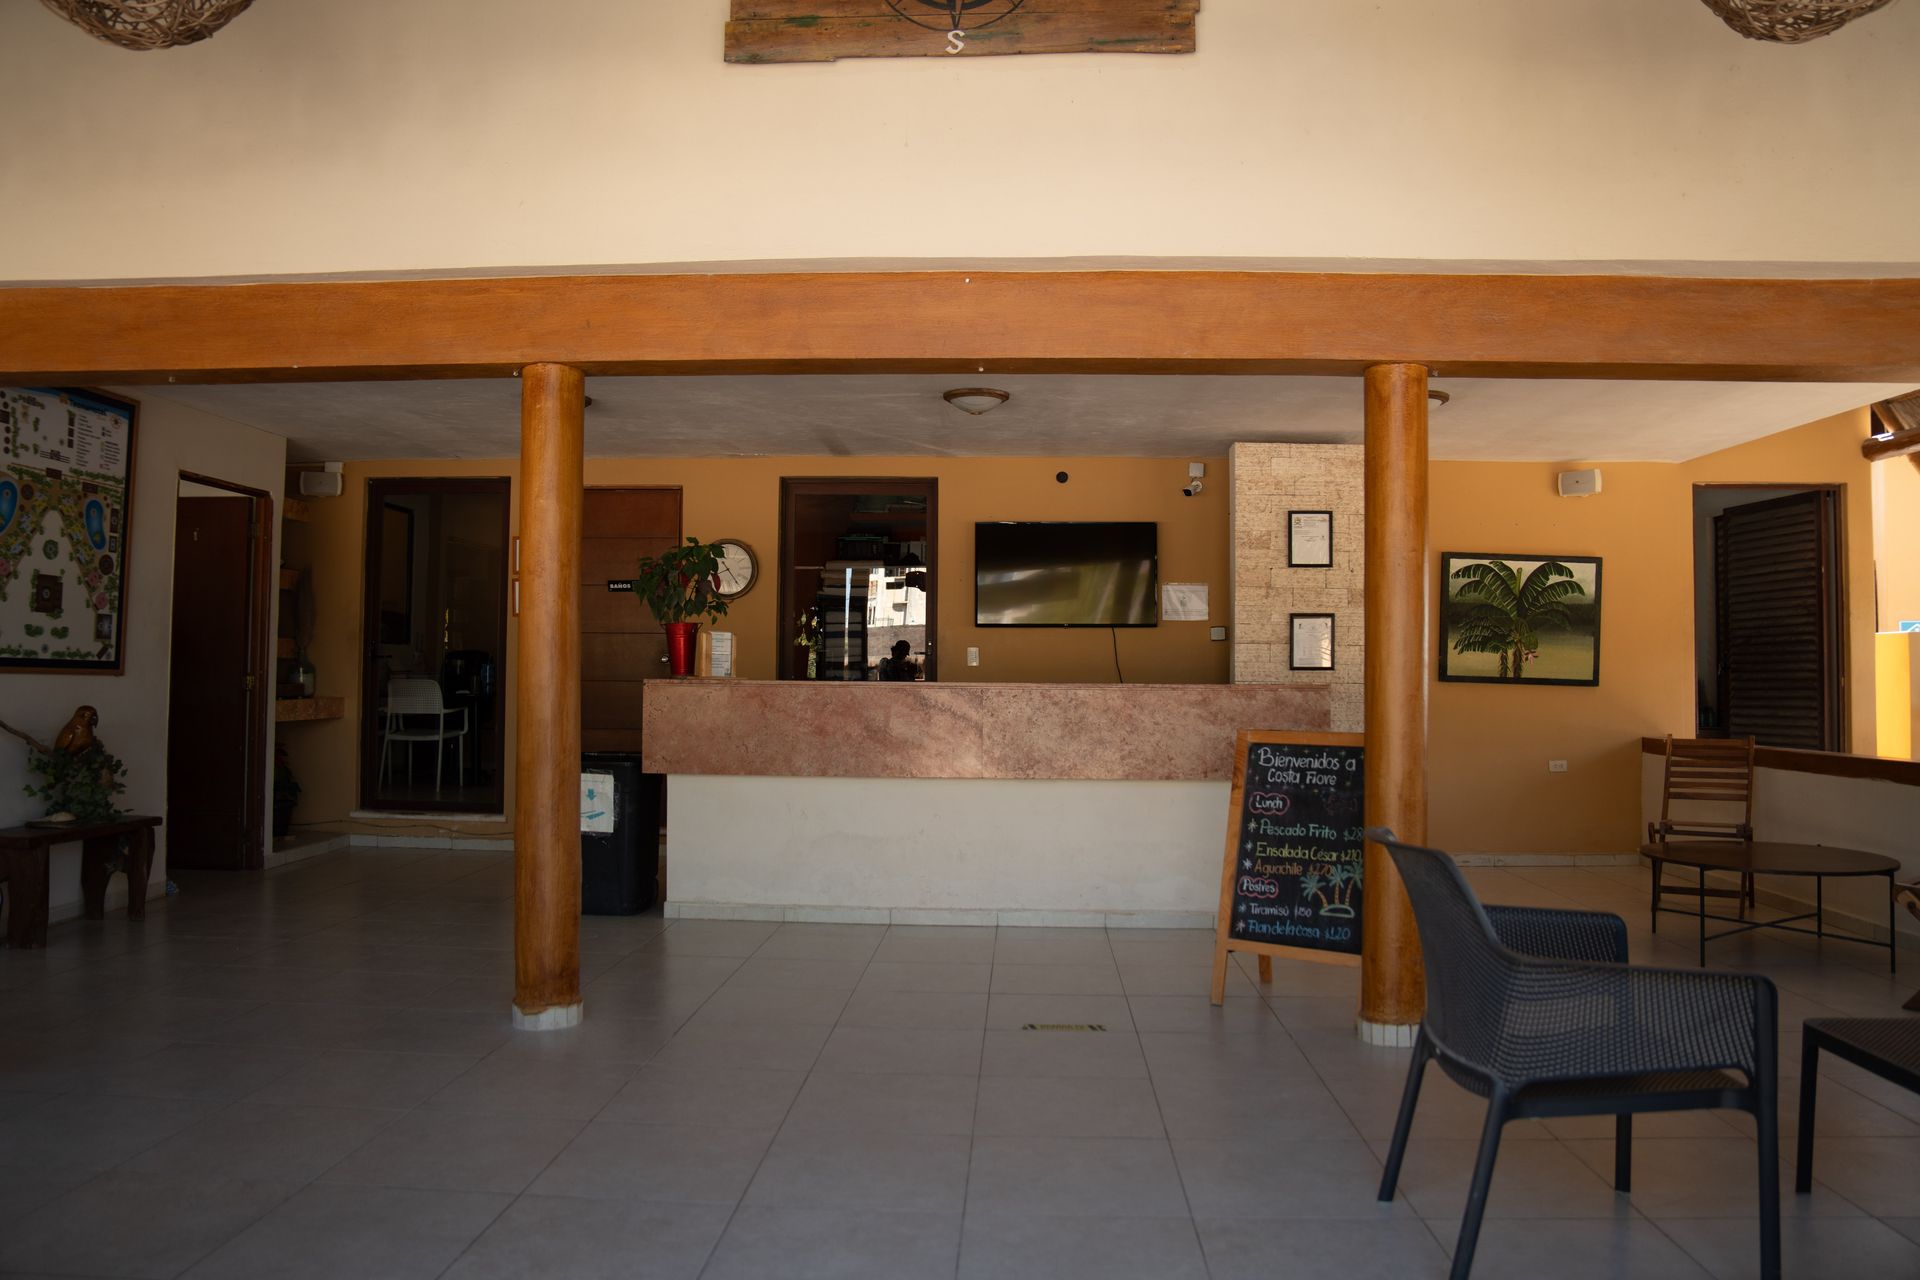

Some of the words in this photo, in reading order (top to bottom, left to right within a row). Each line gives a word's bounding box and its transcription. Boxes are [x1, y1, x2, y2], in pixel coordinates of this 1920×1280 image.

[945, 30, 965, 55] S
[1258, 746, 1340, 771] Bienvenidos
[1345, 757, 1356, 771] a
[1267, 768, 1300, 784] Costa
[1305, 771, 1337, 785] Fiore
[1255, 795, 1283, 809] Lunch
[1259, 818, 1306, 837] Pescado
[1308, 823, 1337, 840] Frito
[1255, 841, 1309, 860] Ensalada
[1254, 858, 1303, 878] Aguachile
[1242, 878, 1276, 894] Postres
